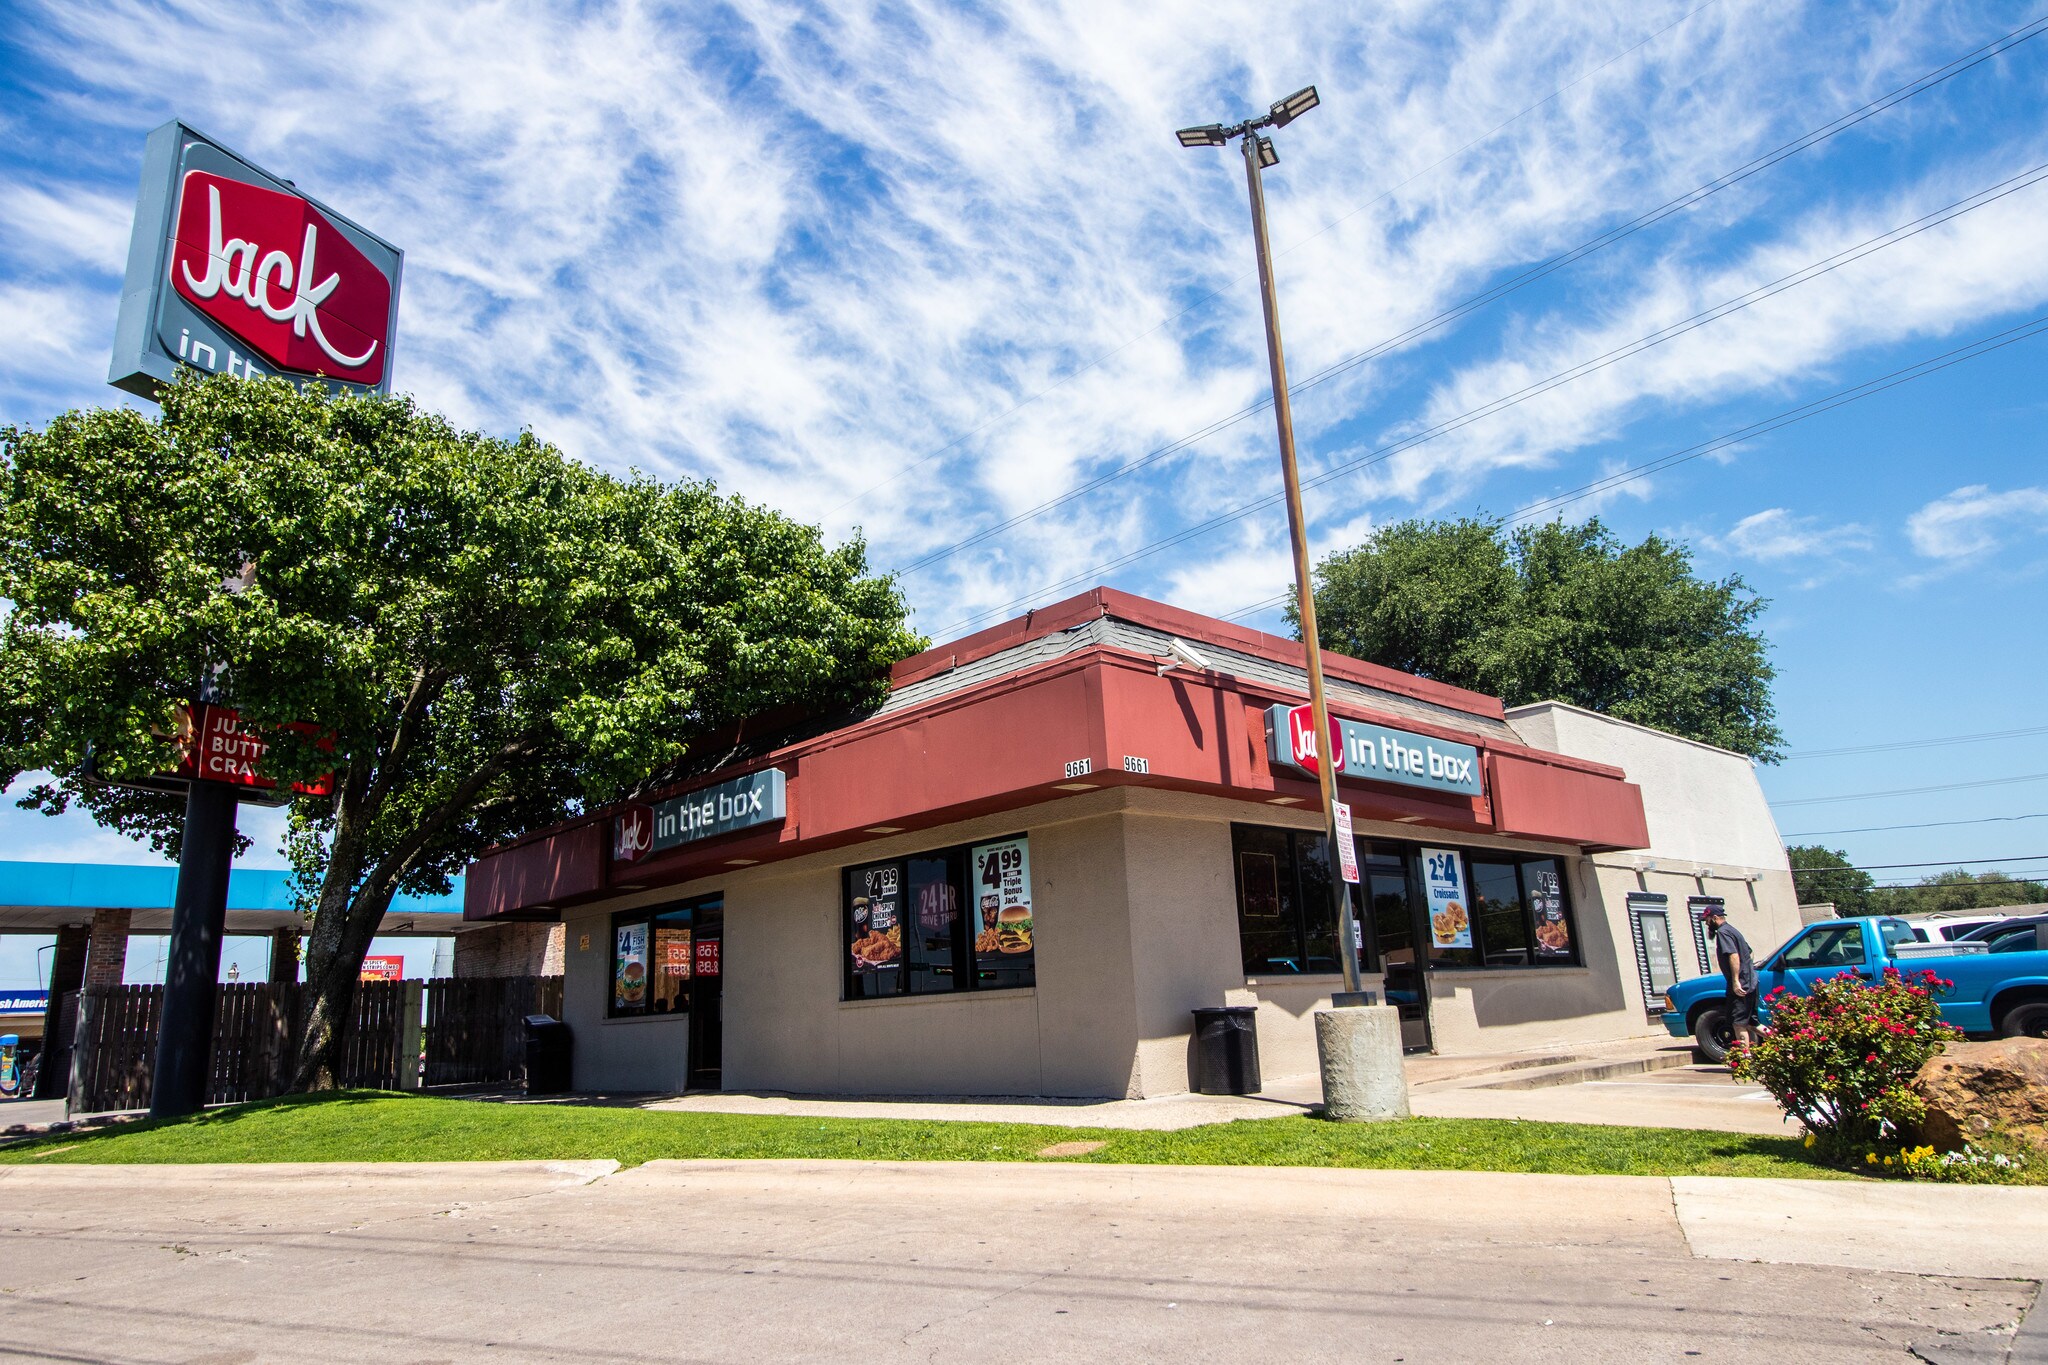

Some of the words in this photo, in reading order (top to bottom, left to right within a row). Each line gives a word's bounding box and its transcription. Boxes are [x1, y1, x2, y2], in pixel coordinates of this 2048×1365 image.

[182, 184, 379, 367] Jack
[178, 328, 216, 370] in
[227, 350, 267, 382] th
[1350, 729, 1377, 766] in
[1380, 736, 1424, 774] the
[1427, 746, 1472, 783] box
[1066, 759, 1091, 777] 9661
[1124, 757, 1148, 773] 9661
[620, 810, 650, 854] Jack
[658, 811, 675, 838] in
[680, 802, 714, 832] the
[719, 788, 763, 822] box
[1003, 877, 1021, 887] Triple
[920, 884, 937, 915] 24
[939, 882, 957, 912] HR
[1003, 886, 1023, 896] Bonus
[1433, 888, 1460, 900] Croissants
[1004, 895, 1018, 905] Jack
[921, 914, 938, 926] DRIVE
[940, 911, 958, 925] THRU
[632, 936, 645, 946] FISH
[11, 999, 48, 1009] Americ
